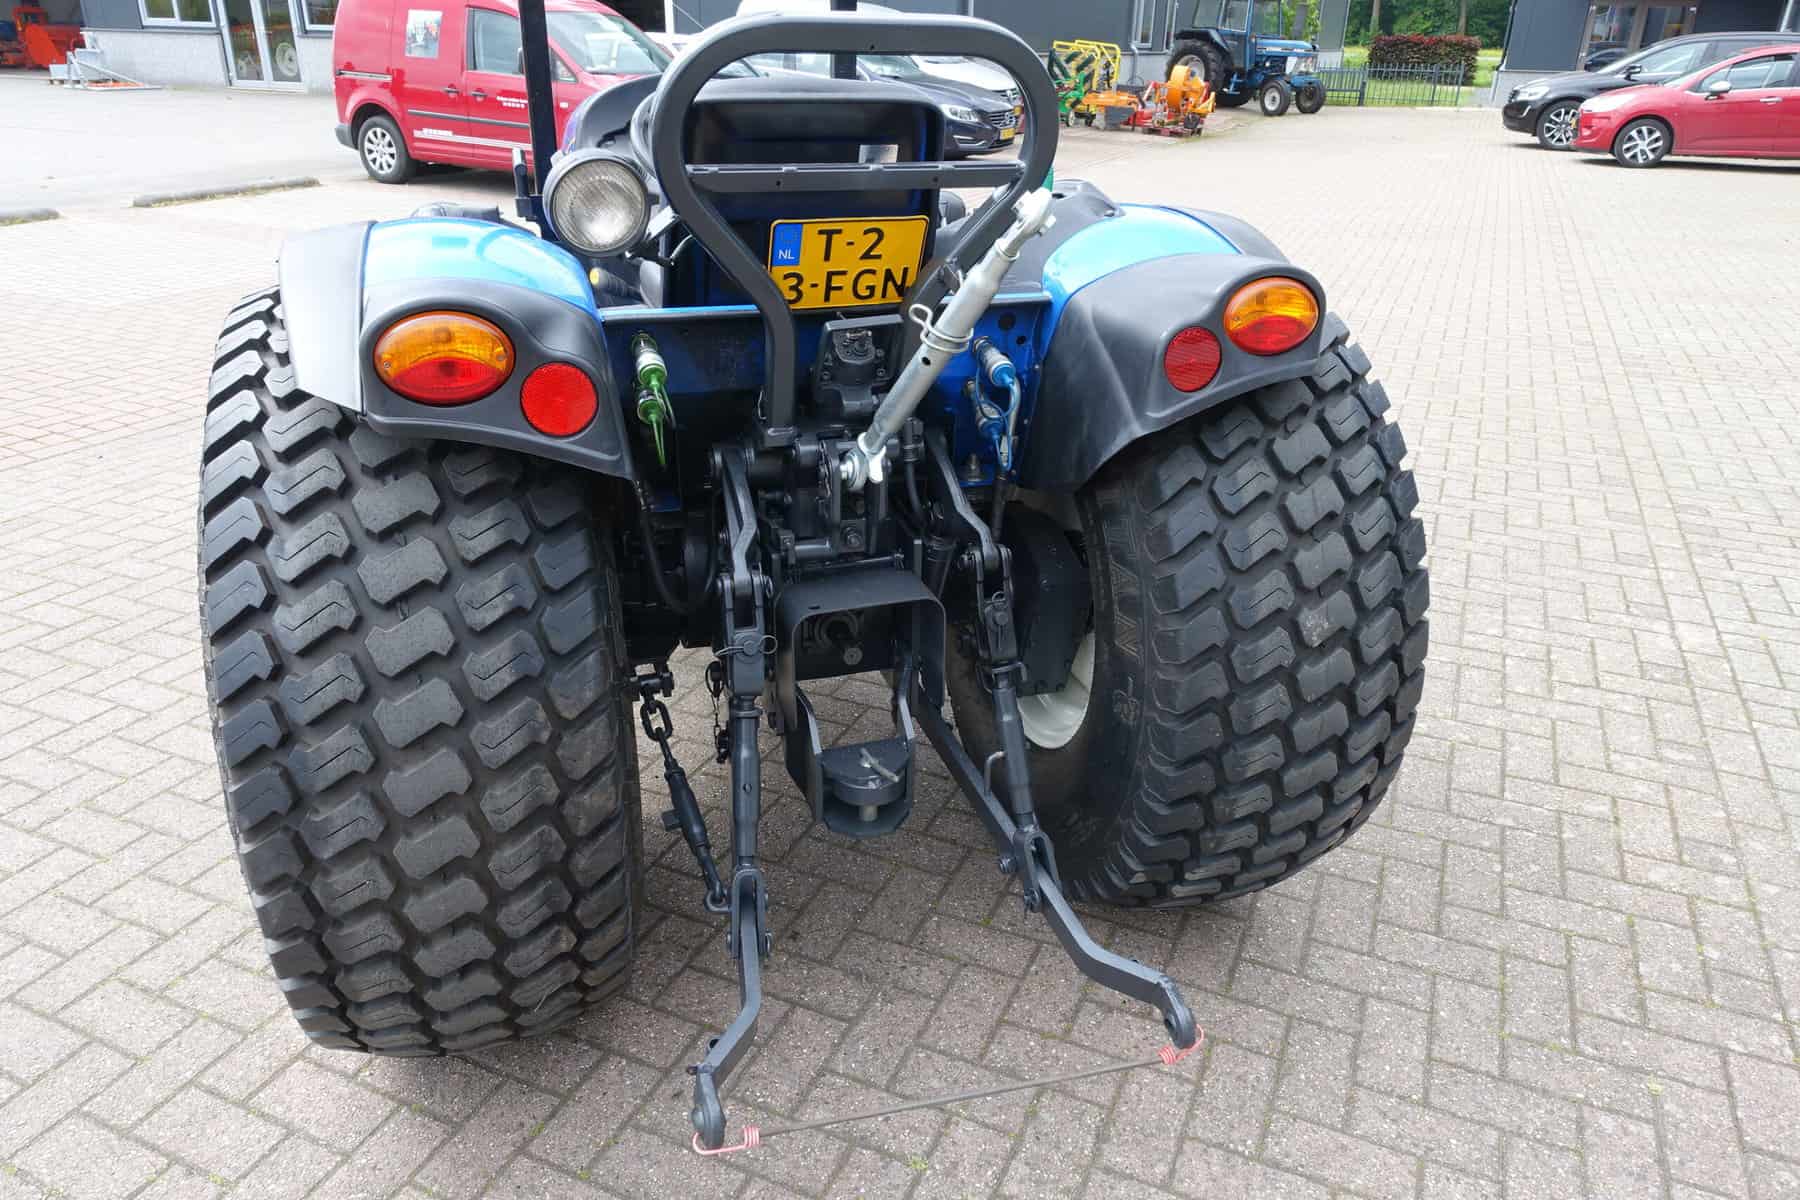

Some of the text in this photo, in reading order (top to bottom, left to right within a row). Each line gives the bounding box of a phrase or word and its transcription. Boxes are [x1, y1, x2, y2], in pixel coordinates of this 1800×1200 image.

[778, 249, 795, 260] NL
[817, 227, 885, 262] T-2
[783, 267, 909, 304] 3-FGN
